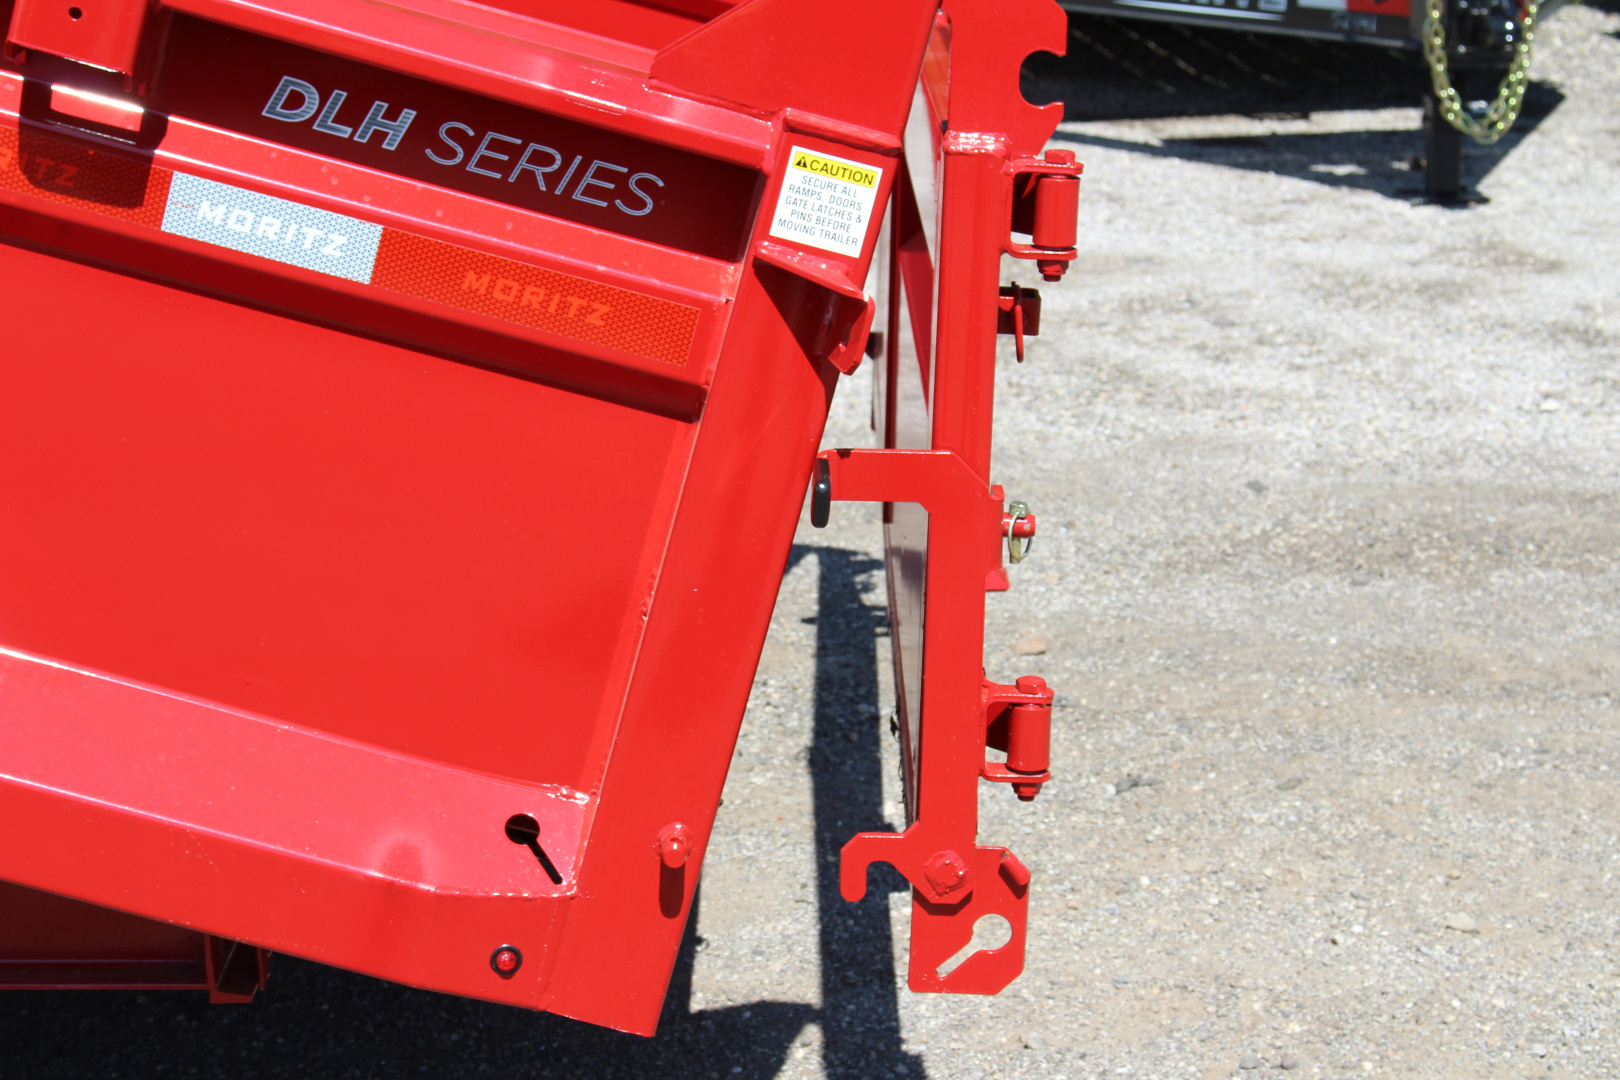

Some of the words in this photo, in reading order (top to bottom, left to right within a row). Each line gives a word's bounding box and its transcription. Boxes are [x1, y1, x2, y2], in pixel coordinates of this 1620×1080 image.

[261, 75, 417, 151] DLH
[424, 121, 665, 216] SERIES
[801, 175, 841, 193] SECURE
[841, 186, 858, 198] ALL
[809, 159, 874, 186] CAUTION
[785, 195, 809, 210] GATE
[811, 203, 853, 221] LATCHES
[856, 215, 862, 224] &
[790, 209, 812, 223] PINS
[815, 216, 852, 233] BEFORE
[197, 200, 348, 257] MORITZ
[778, 218, 816, 236] MOVING
[819, 229, 858, 247] TRAILER
[461, 269, 610, 326] MORITZ
